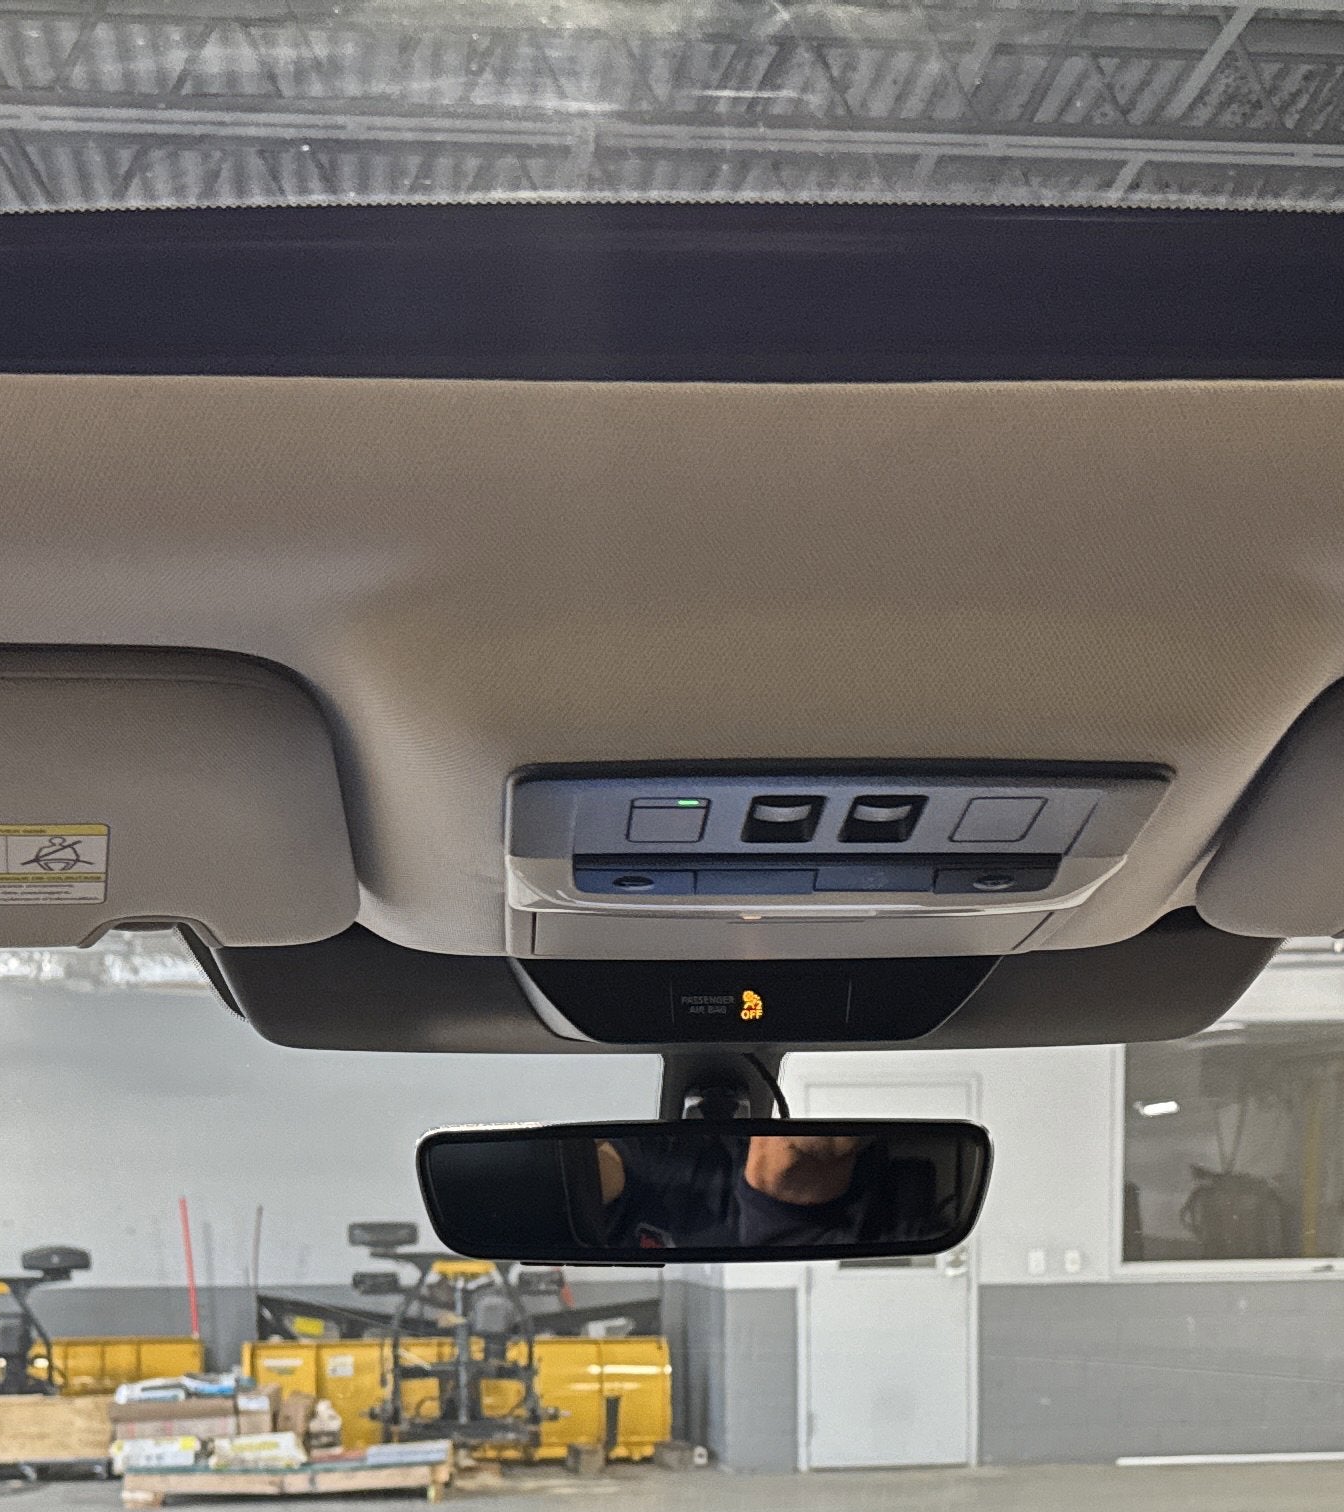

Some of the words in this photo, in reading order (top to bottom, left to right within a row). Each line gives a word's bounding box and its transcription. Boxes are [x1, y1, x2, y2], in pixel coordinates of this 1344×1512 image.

[681, 995, 735, 1004] PASSENGER
[689, 1005, 705, 1014] AIR
[740, 1009, 763, 1019] OFF
